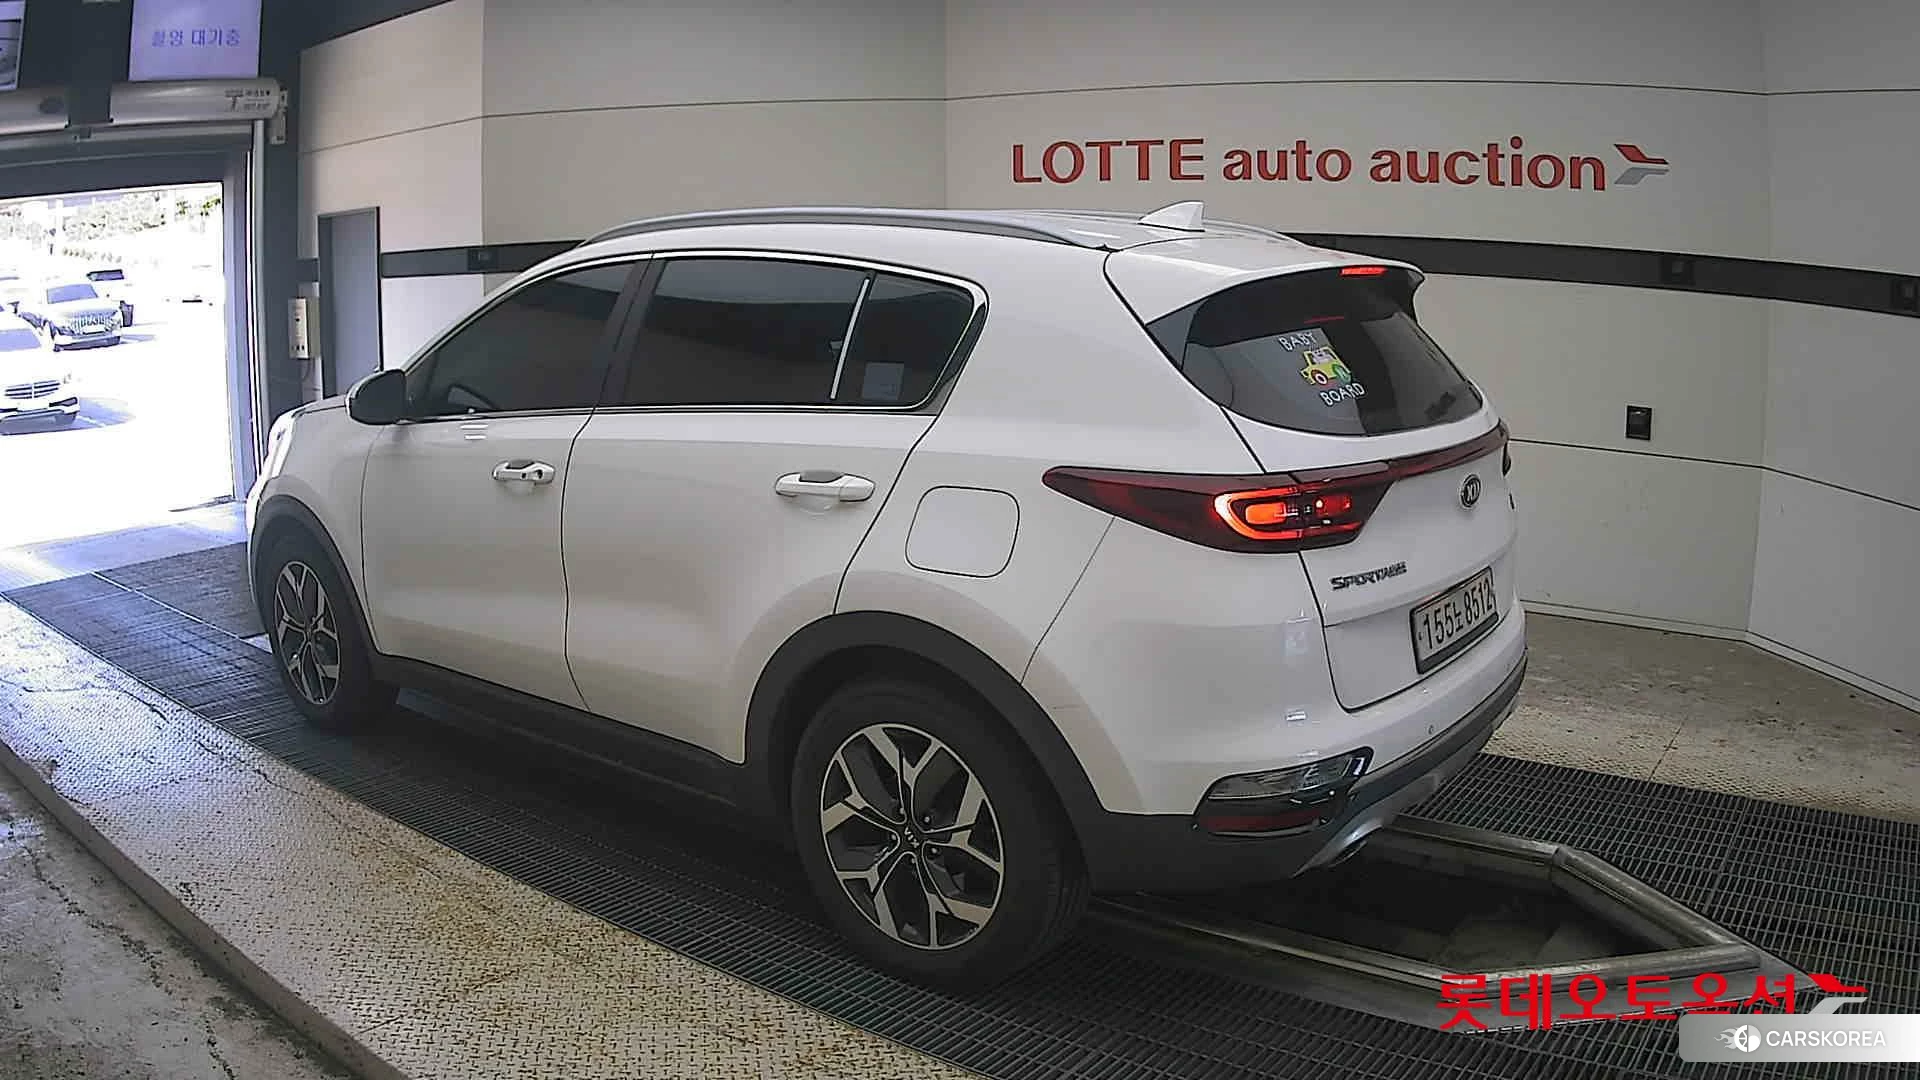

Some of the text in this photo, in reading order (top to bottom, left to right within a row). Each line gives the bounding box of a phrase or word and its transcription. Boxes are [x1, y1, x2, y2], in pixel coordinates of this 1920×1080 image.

[1012, 137, 1606, 191] LOTTE auto auction
[1279, 332, 1317, 351] BABY
[1320, 382, 1365, 406] BOARD
[1423, 578, 1492, 649] 155노 8512
